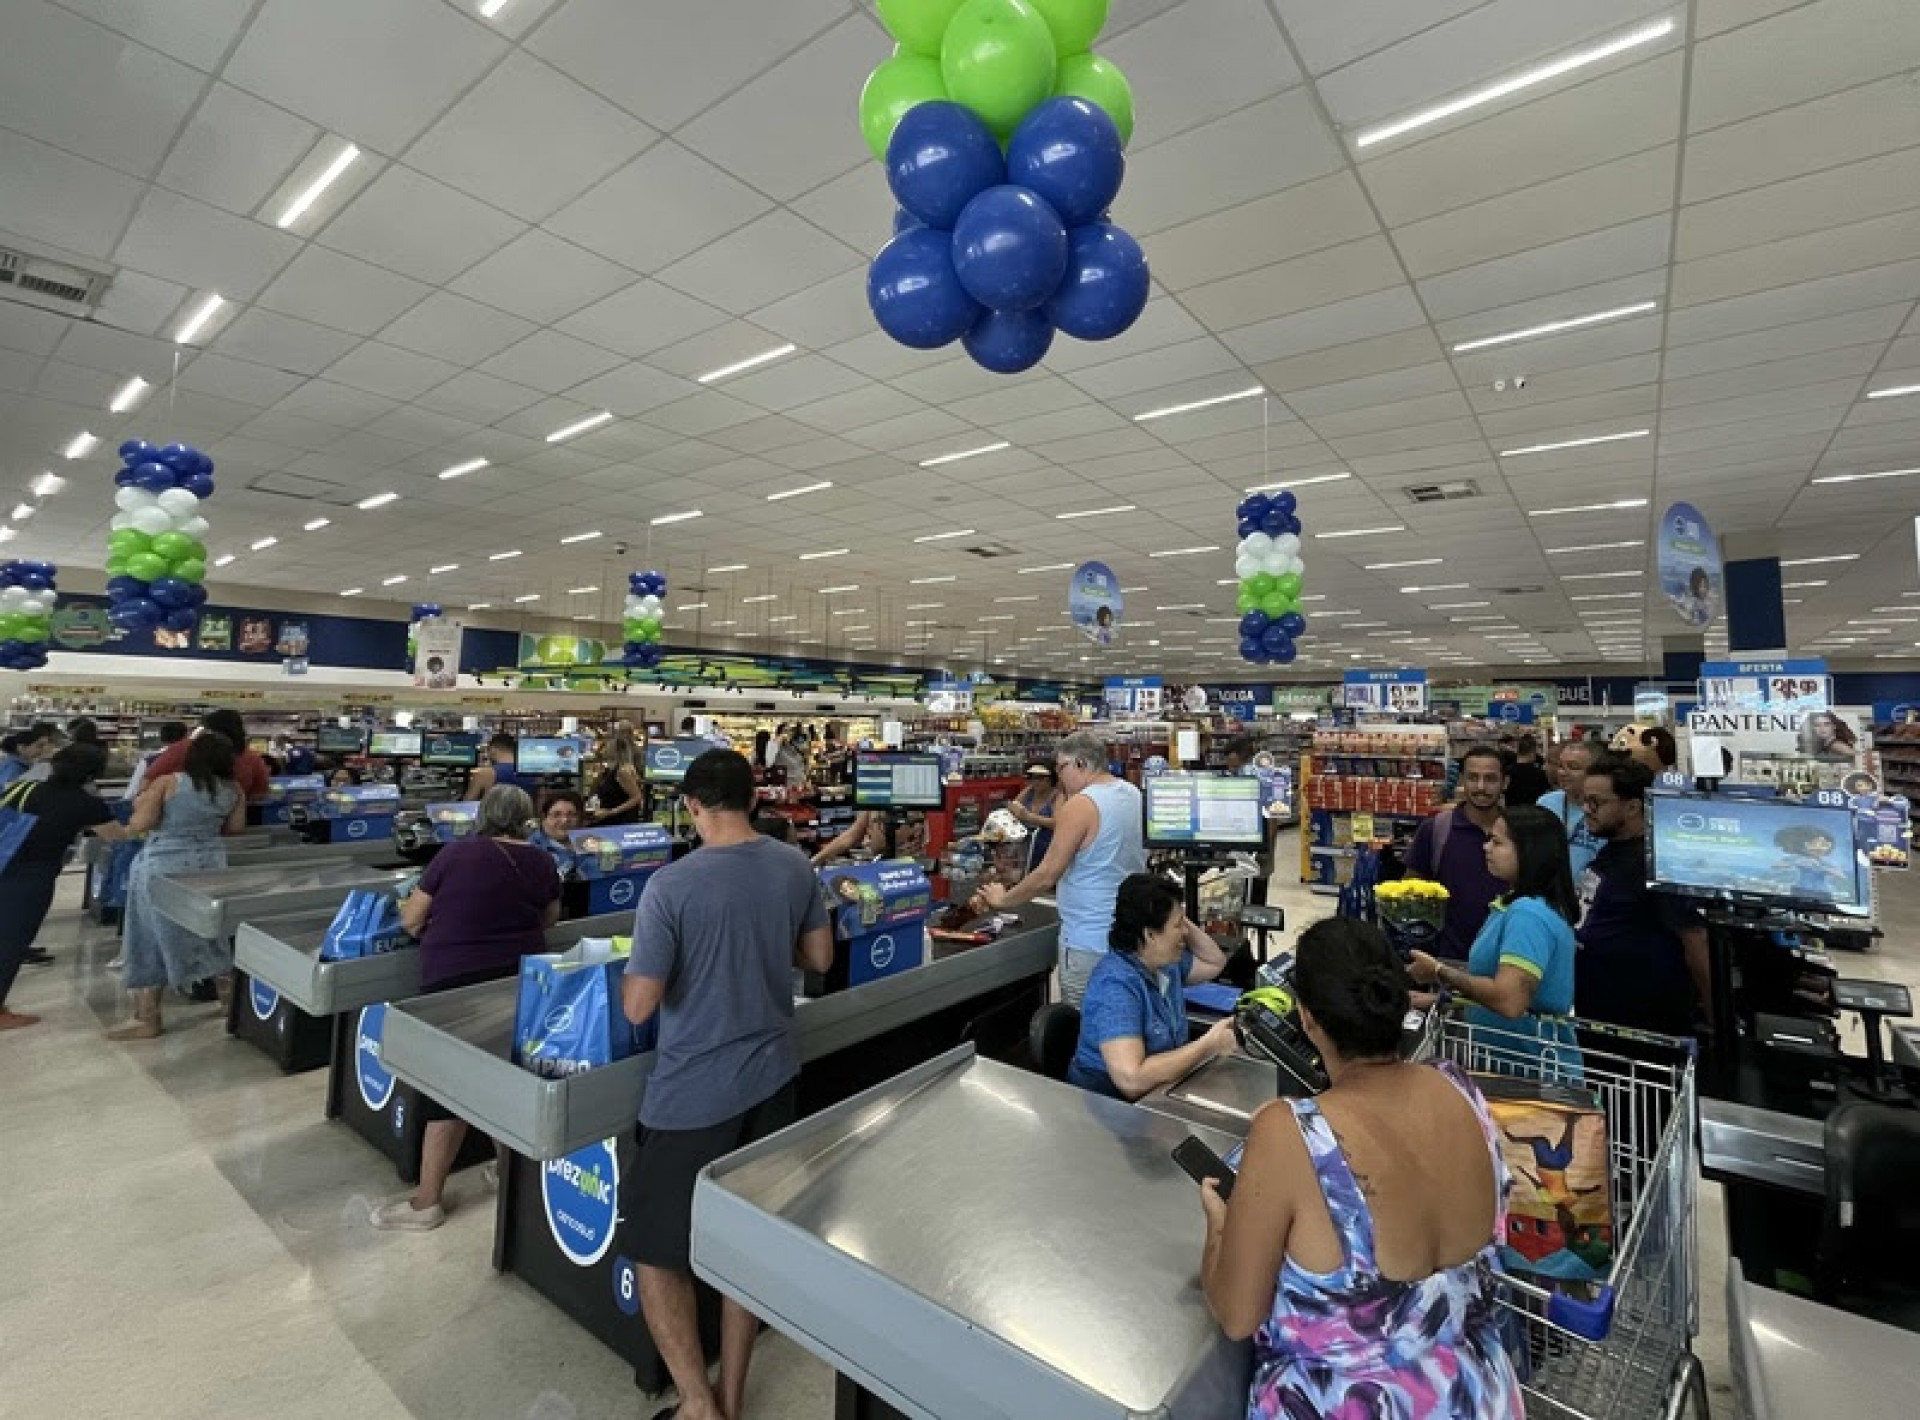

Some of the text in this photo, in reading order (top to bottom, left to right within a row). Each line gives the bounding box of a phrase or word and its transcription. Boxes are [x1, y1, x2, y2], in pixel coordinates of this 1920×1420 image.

[1739, 663, 1784, 673] OFERTA
[1691, 714, 1800, 732] PANTENE
[1662, 772, 1683, 786] 08
[1818, 791, 1844, 806] 08
[621, 1267, 635, 1301] 6
